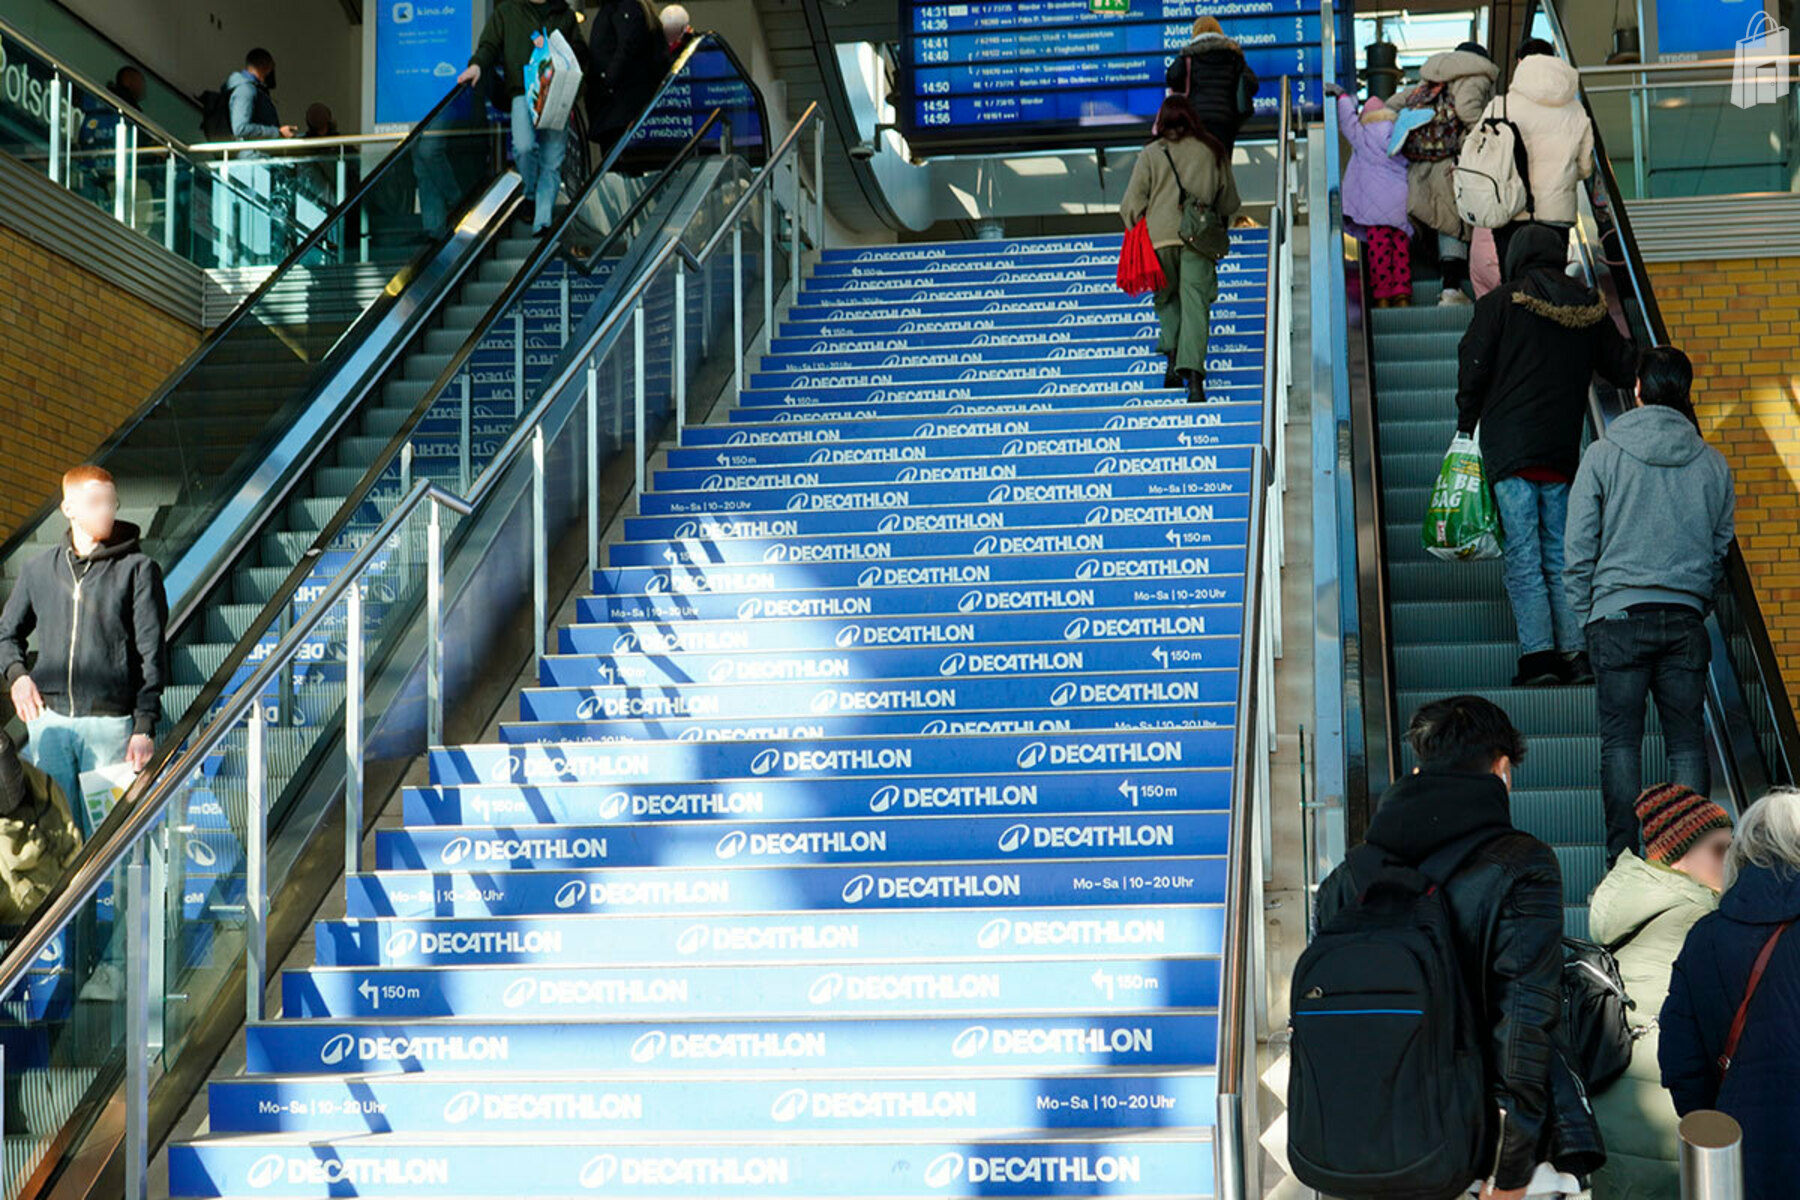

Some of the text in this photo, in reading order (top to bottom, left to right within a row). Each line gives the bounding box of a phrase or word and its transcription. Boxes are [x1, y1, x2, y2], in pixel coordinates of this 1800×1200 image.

[1163, 2, 1272, 17] Berlin Gesundbrunnen
[874, 250, 946, 262] DECATHLON
[1021, 242, 1093, 252] DECATHLON
[942, 261, 1014, 272] DECATHLON
[1011, 271, 1086, 281] DECATHLON
[860, 278, 934, 289] DECATHLON
[929, 290, 1004, 301] DECATHLON
[845, 309, 921, 320] DECATHLON
[1001, 301, 1079, 311] DECATHLON
[917, 320, 994, 332] DECATHLON
[1077, 312, 1155, 324] DECATHLON
[830, 340, 908, 353] DECATHLON
[992, 332, 1071, 345] DECATHLON
[902, 353, 982, 366] DECATHLON
[1068, 346, 1150, 359] DECATHLON
[811, 375, 893, 388] DECATHLON
[979, 367, 1061, 380] DECATHLON
[888, 389, 971, 403] DECATHLON
[1059, 382, 1144, 395] DECATHLON
[937, 422, 1029, 437] DECATHLON
[1128, 414, 1221, 429] DECATHLON
[750, 430, 840, 444] DECATHLON
[1026, 437, 1121, 455] DECATHLON
[833, 447, 926, 463] DECATHLON
[1119, 456, 1217, 472] DECATHLON
[725, 474, 819, 489] DECATHLON
[920, 465, 1016, 483] DECATHLON
[812, 492, 908, 509] DECATHLON
[1013, 484, 1112, 501] DECATHLON
[903, 513, 1004, 533] DECATHLON
[1112, 505, 1214, 523] DECATHLON
[700, 520, 797, 538] DECATHLON
[789, 543, 891, 561] DECATHLON
[1000, 535, 1104, 553] DECATHLON
[884, 565, 989, 585] DECATHLON
[1103, 558, 1210, 577] DECATHLON
[765, 598, 871, 617] DECATHLON
[986, 589, 1094, 610] DECATHLON
[864, 624, 975, 644] DECATHLON
[1092, 617, 1205, 637] DECATHLON
[641, 631, 748, 651] DECATHLON
[739, 659, 848, 679] DECATHLON
[969, 652, 1083, 672] DECATHLON
[840, 690, 956, 710] DECATHLON
[1080, 682, 1199, 702] DECATHLON
[605, 695, 719, 717] DECATHLON
[707, 727, 824, 741] DECATHLON
[950, 720, 1070, 735] DECATHLON
[783, 749, 911, 772] DECATHLON
[1050, 742, 1182, 764] DECATHLON
[523, 756, 649, 778] DECATHLON
[632, 792, 763, 816] DECATHLON
[903, 785, 1037, 809] DECATHLON
[750, 831, 886, 856] DECATHLON
[1034, 825, 1174, 848] DECATHLON
[475, 838, 607, 861] DECATHLON
[590, 880, 729, 905] DECATHLON
[878, 875, 1020, 899] DECATHLON
[421, 930, 562, 954] DECATHLON
[713, 925, 858, 950] DECATHLON
[1015, 920, 1164, 945] DECATHLON
[540, 979, 688, 1005] DECATHLON
[847, 974, 1000, 998] DECATHLON
[359, 1036, 508, 1061] DECATHLON
[670, 1032, 825, 1058] DECATHLON
[993, 1028, 1153, 1053] DECATHLON
[484, 1093, 642, 1120] DECATHLON
[813, 1091, 976, 1118] DECATHLON
[287, 1158, 448, 1185] DECATHLON
[621, 1158, 789, 1185] DECATHLON
[968, 1156, 1140, 1184] DECATHLON
